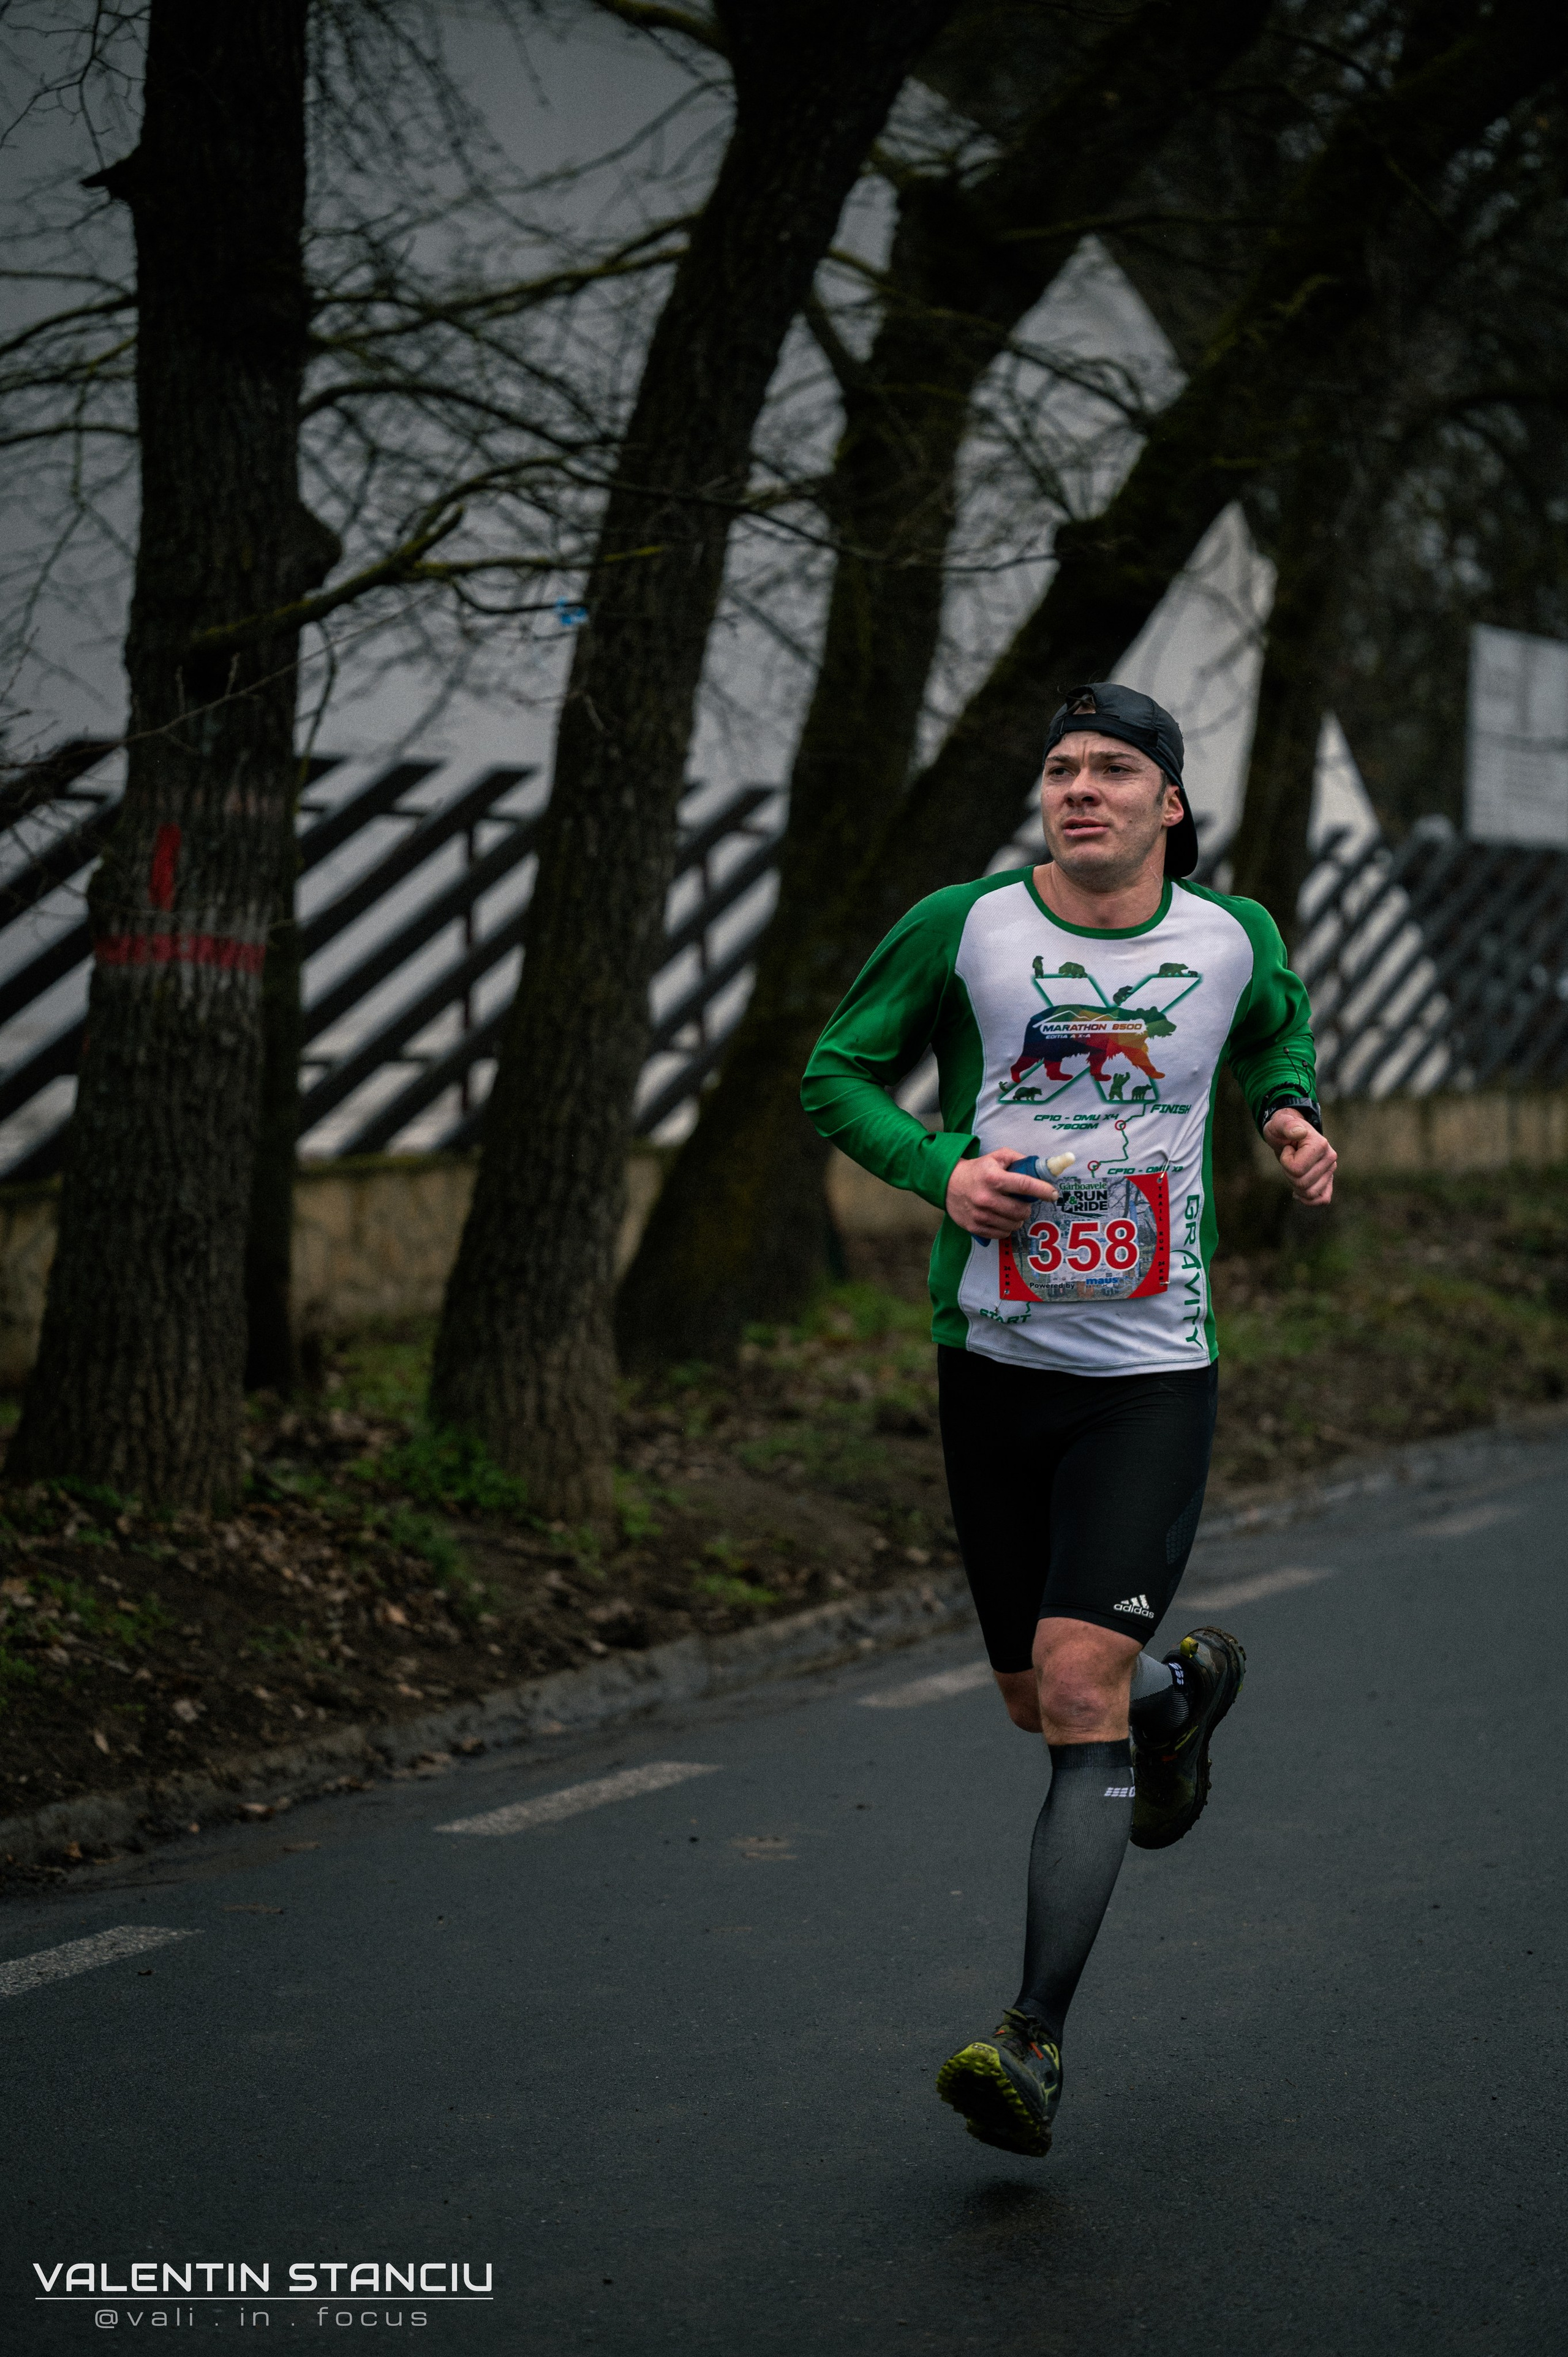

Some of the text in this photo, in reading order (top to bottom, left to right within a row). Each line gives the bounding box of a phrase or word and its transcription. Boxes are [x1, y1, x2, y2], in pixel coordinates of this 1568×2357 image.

[1042, 1024, 1107, 1032] MARATHON
[1150, 1104, 1192, 1114] FINISH
[1069, 1195, 1078, 1205] &
[1074, 1190, 1108, 1201] RUN
[1074, 1201, 1108, 1212] RIDE
[1028, 1218, 1140, 1274] 358
[1170, 1194, 1204, 1349] GRAVITY
[1086, 1277, 1118, 1285] maus
[979, 1308, 1031, 1324] START
[1113, 1604, 1155, 1618] adidas
